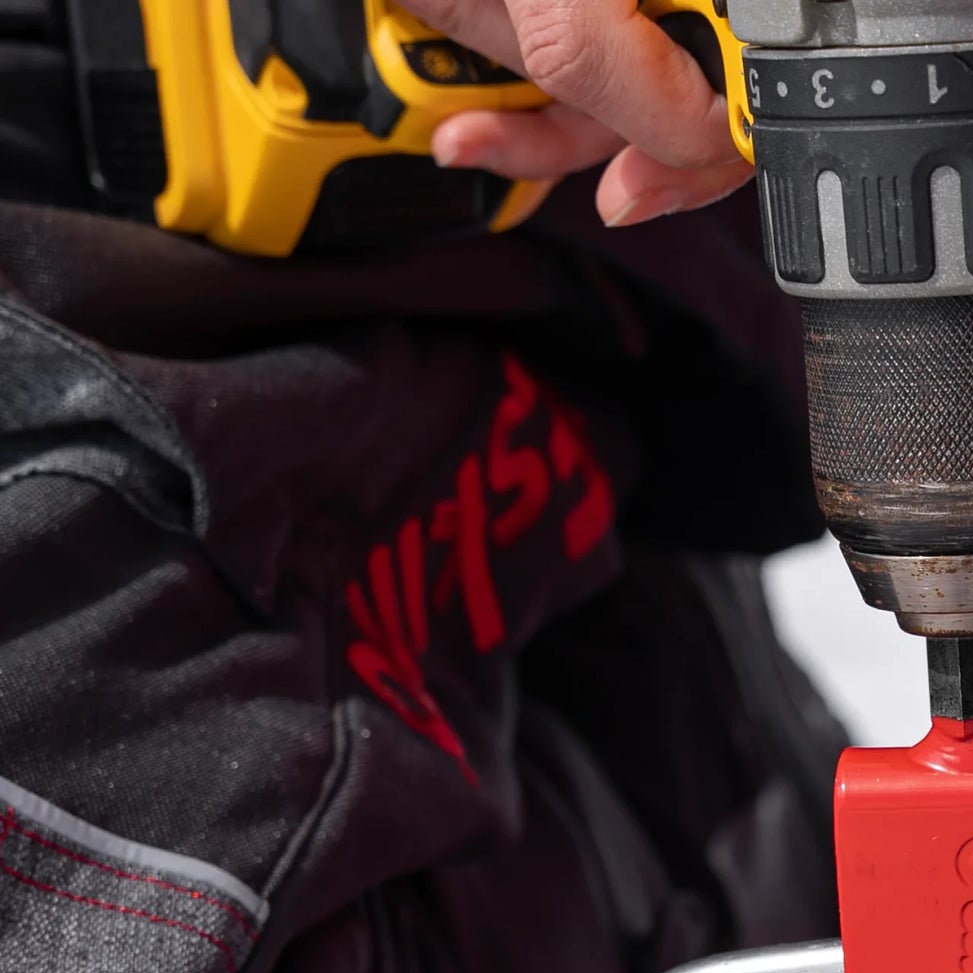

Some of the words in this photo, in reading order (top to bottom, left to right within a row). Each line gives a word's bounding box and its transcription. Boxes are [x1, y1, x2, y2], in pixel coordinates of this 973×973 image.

[749, 67, 762, 109] 5
[811, 68, 836, 109] 3
[926, 63, 949, 104] 1
